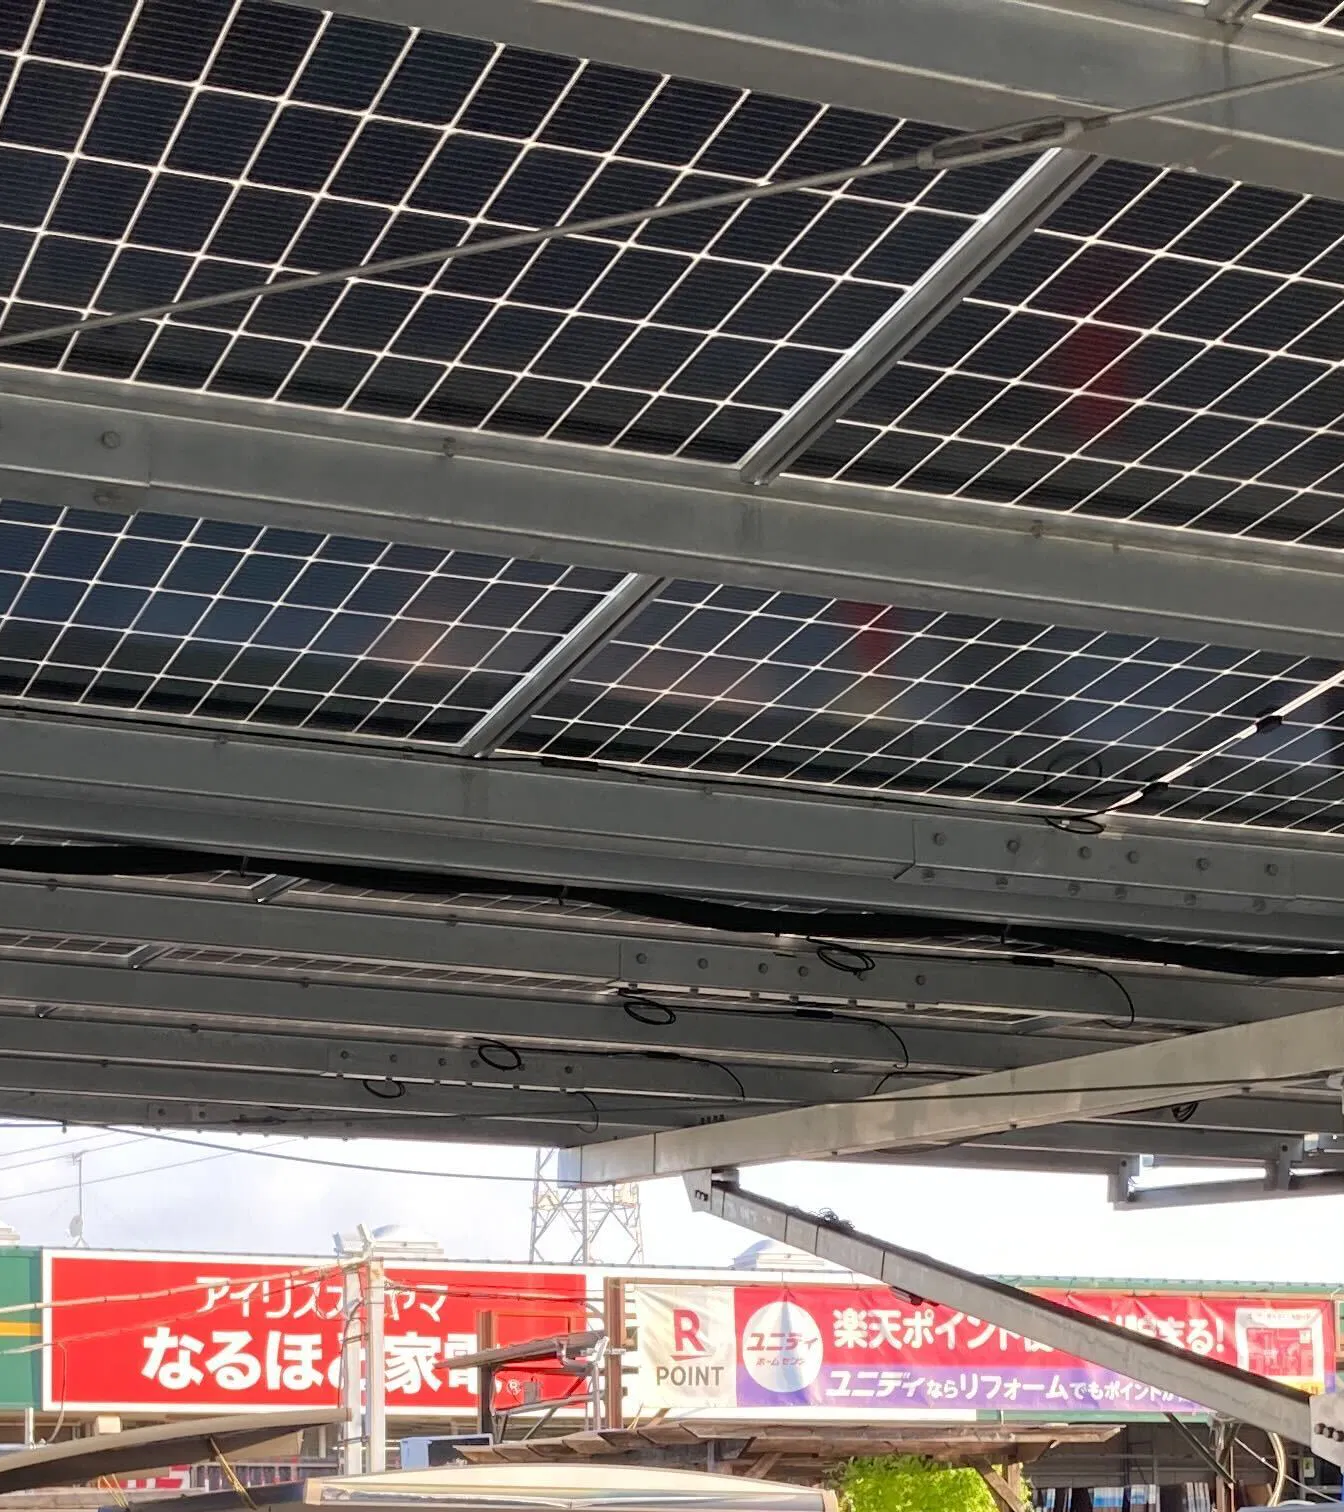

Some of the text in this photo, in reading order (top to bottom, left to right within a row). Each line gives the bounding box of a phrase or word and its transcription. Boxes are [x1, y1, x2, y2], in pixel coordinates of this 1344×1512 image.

[196, 1276, 450, 1322] アイリスヤマ
[673, 1309, 706, 1352] R
[747, 1331, 819, 1352] ユニディ
[656, 1366, 724, 1386] POINT
